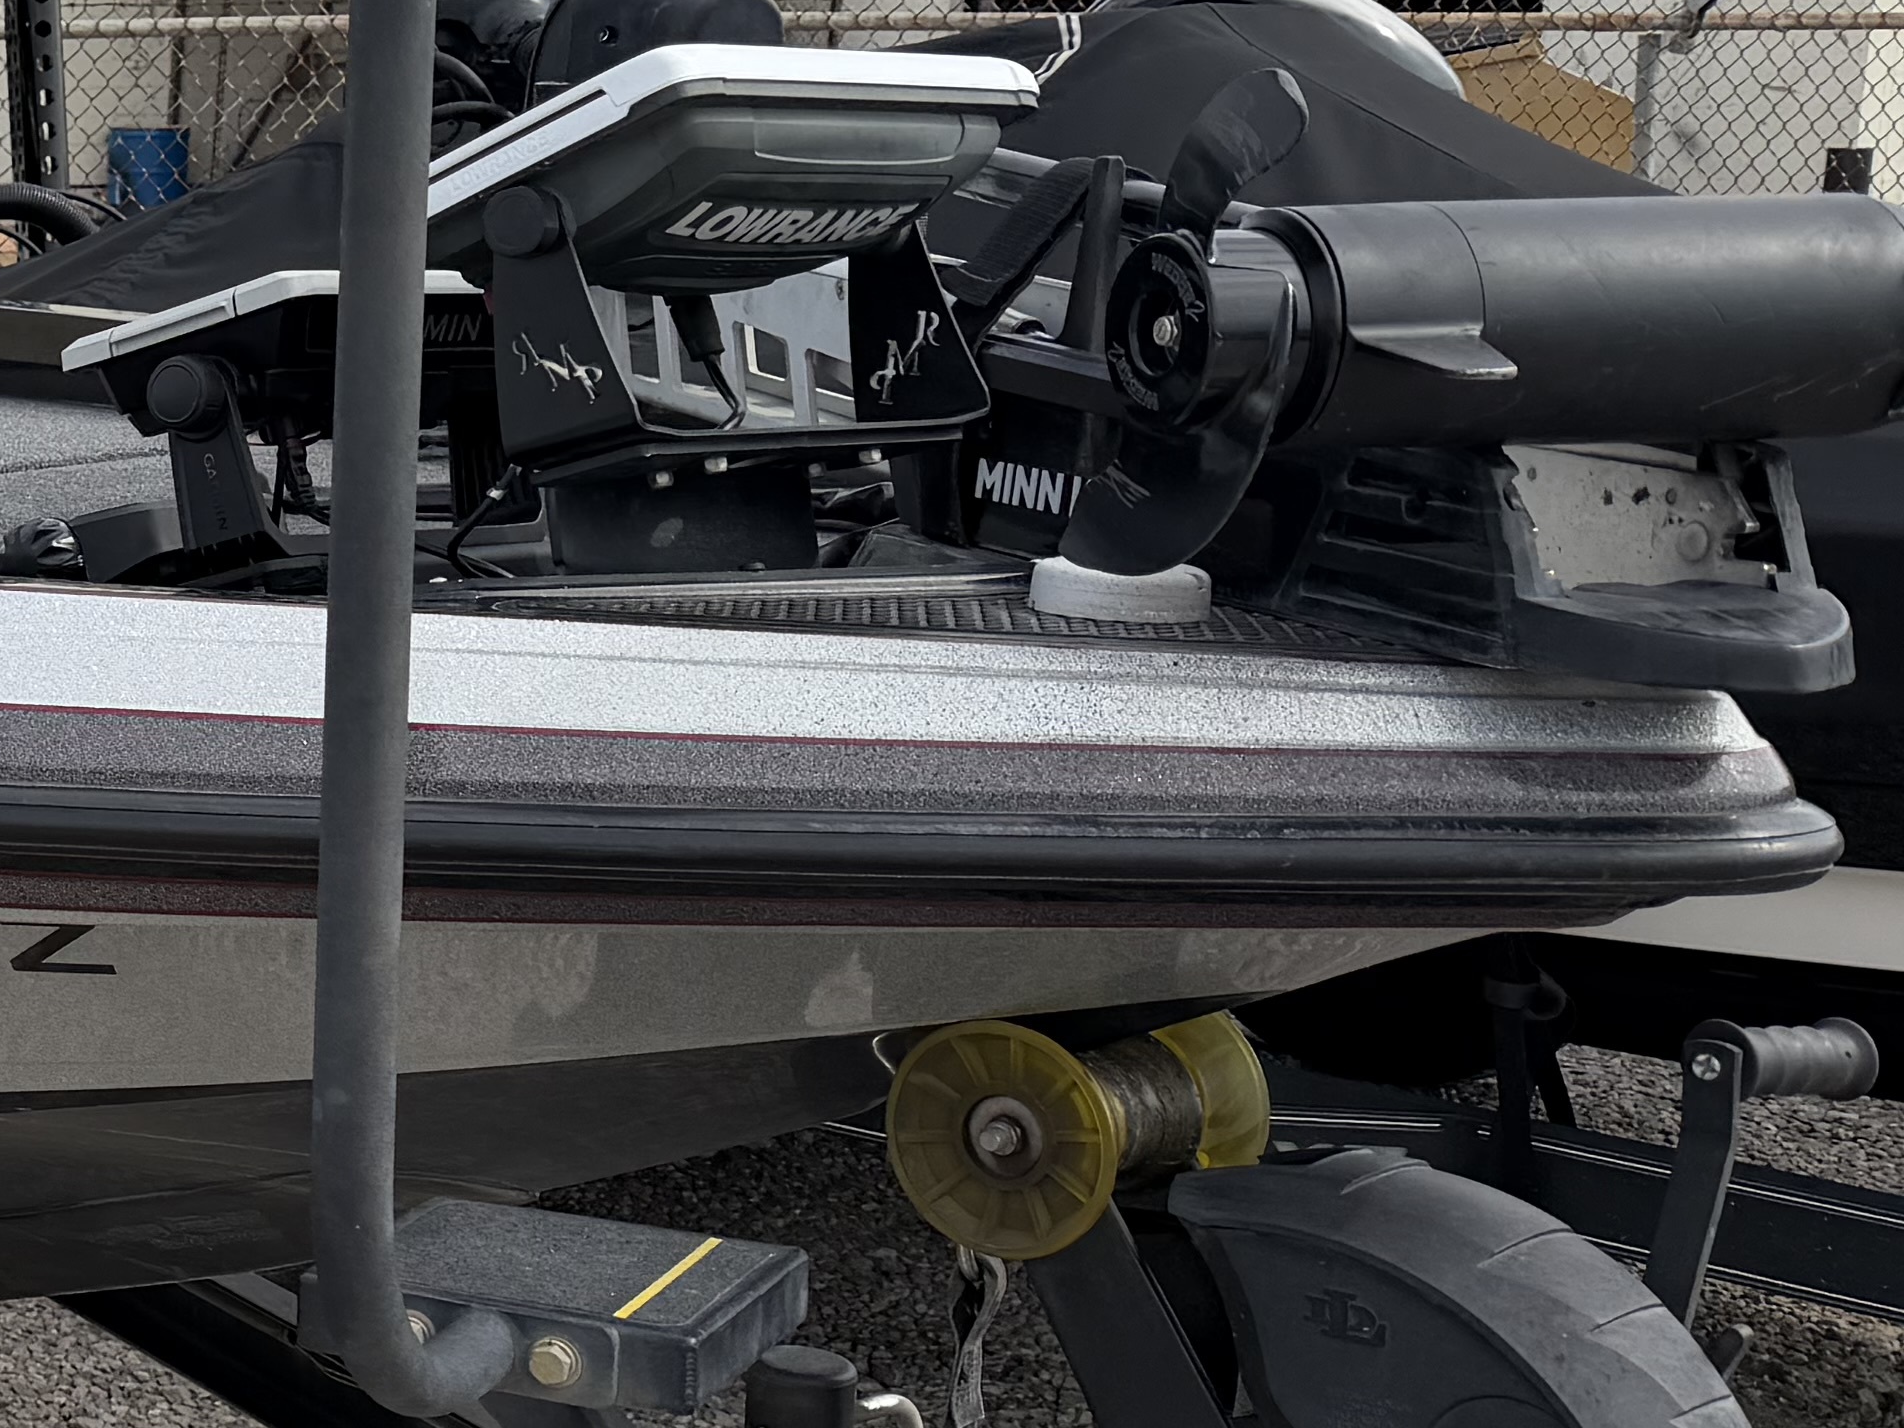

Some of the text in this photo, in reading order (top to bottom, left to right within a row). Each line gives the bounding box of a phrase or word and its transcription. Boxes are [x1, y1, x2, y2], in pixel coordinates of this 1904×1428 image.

[664, 201, 920, 244] LOWRANCE
[423, 313, 483, 342] MIN
[974, 457, 1065, 515] MINN
